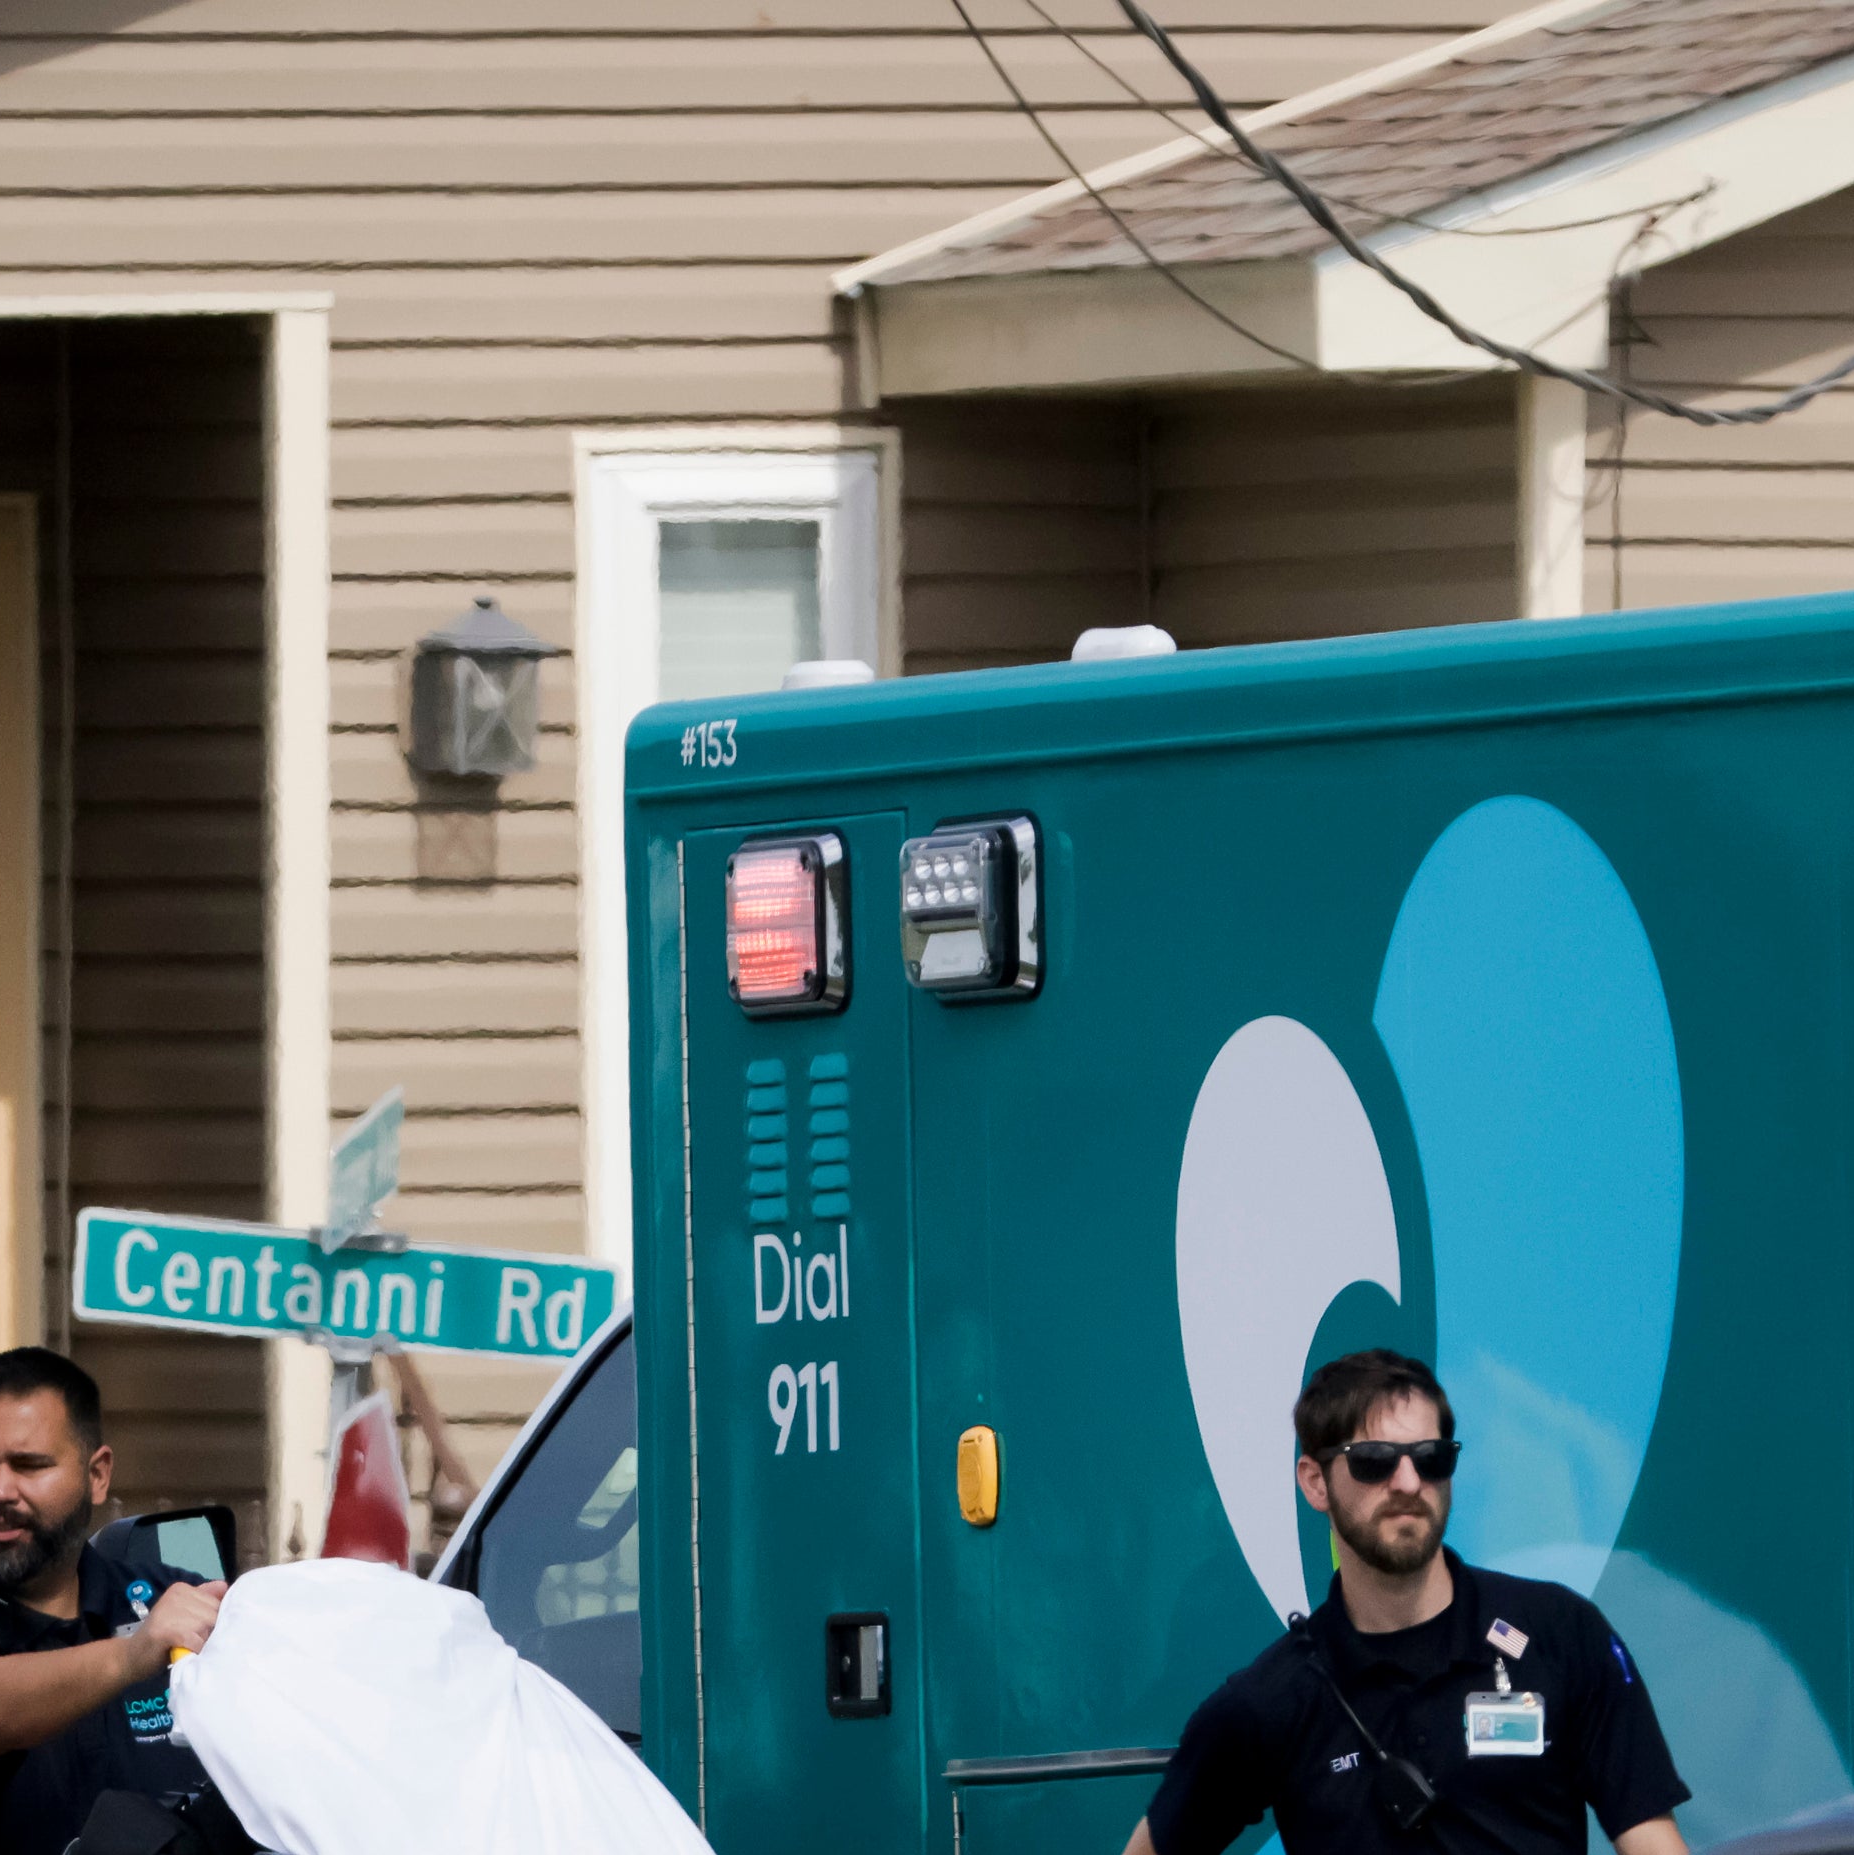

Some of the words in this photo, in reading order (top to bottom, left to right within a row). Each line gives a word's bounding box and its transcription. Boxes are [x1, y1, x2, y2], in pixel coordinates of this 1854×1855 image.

[680, 718, 738, 768] #153
[113, 1227, 447, 1339] Centanni
[495, 1266, 587, 1351] Rd
[753, 1223, 850, 1325] Dial
[767, 1360, 841, 1456] 911
[124, 1697, 165, 1714] LCMC
[129, 1713, 174, 1730] Health
[1330, 1752, 1360, 1773] EMT
